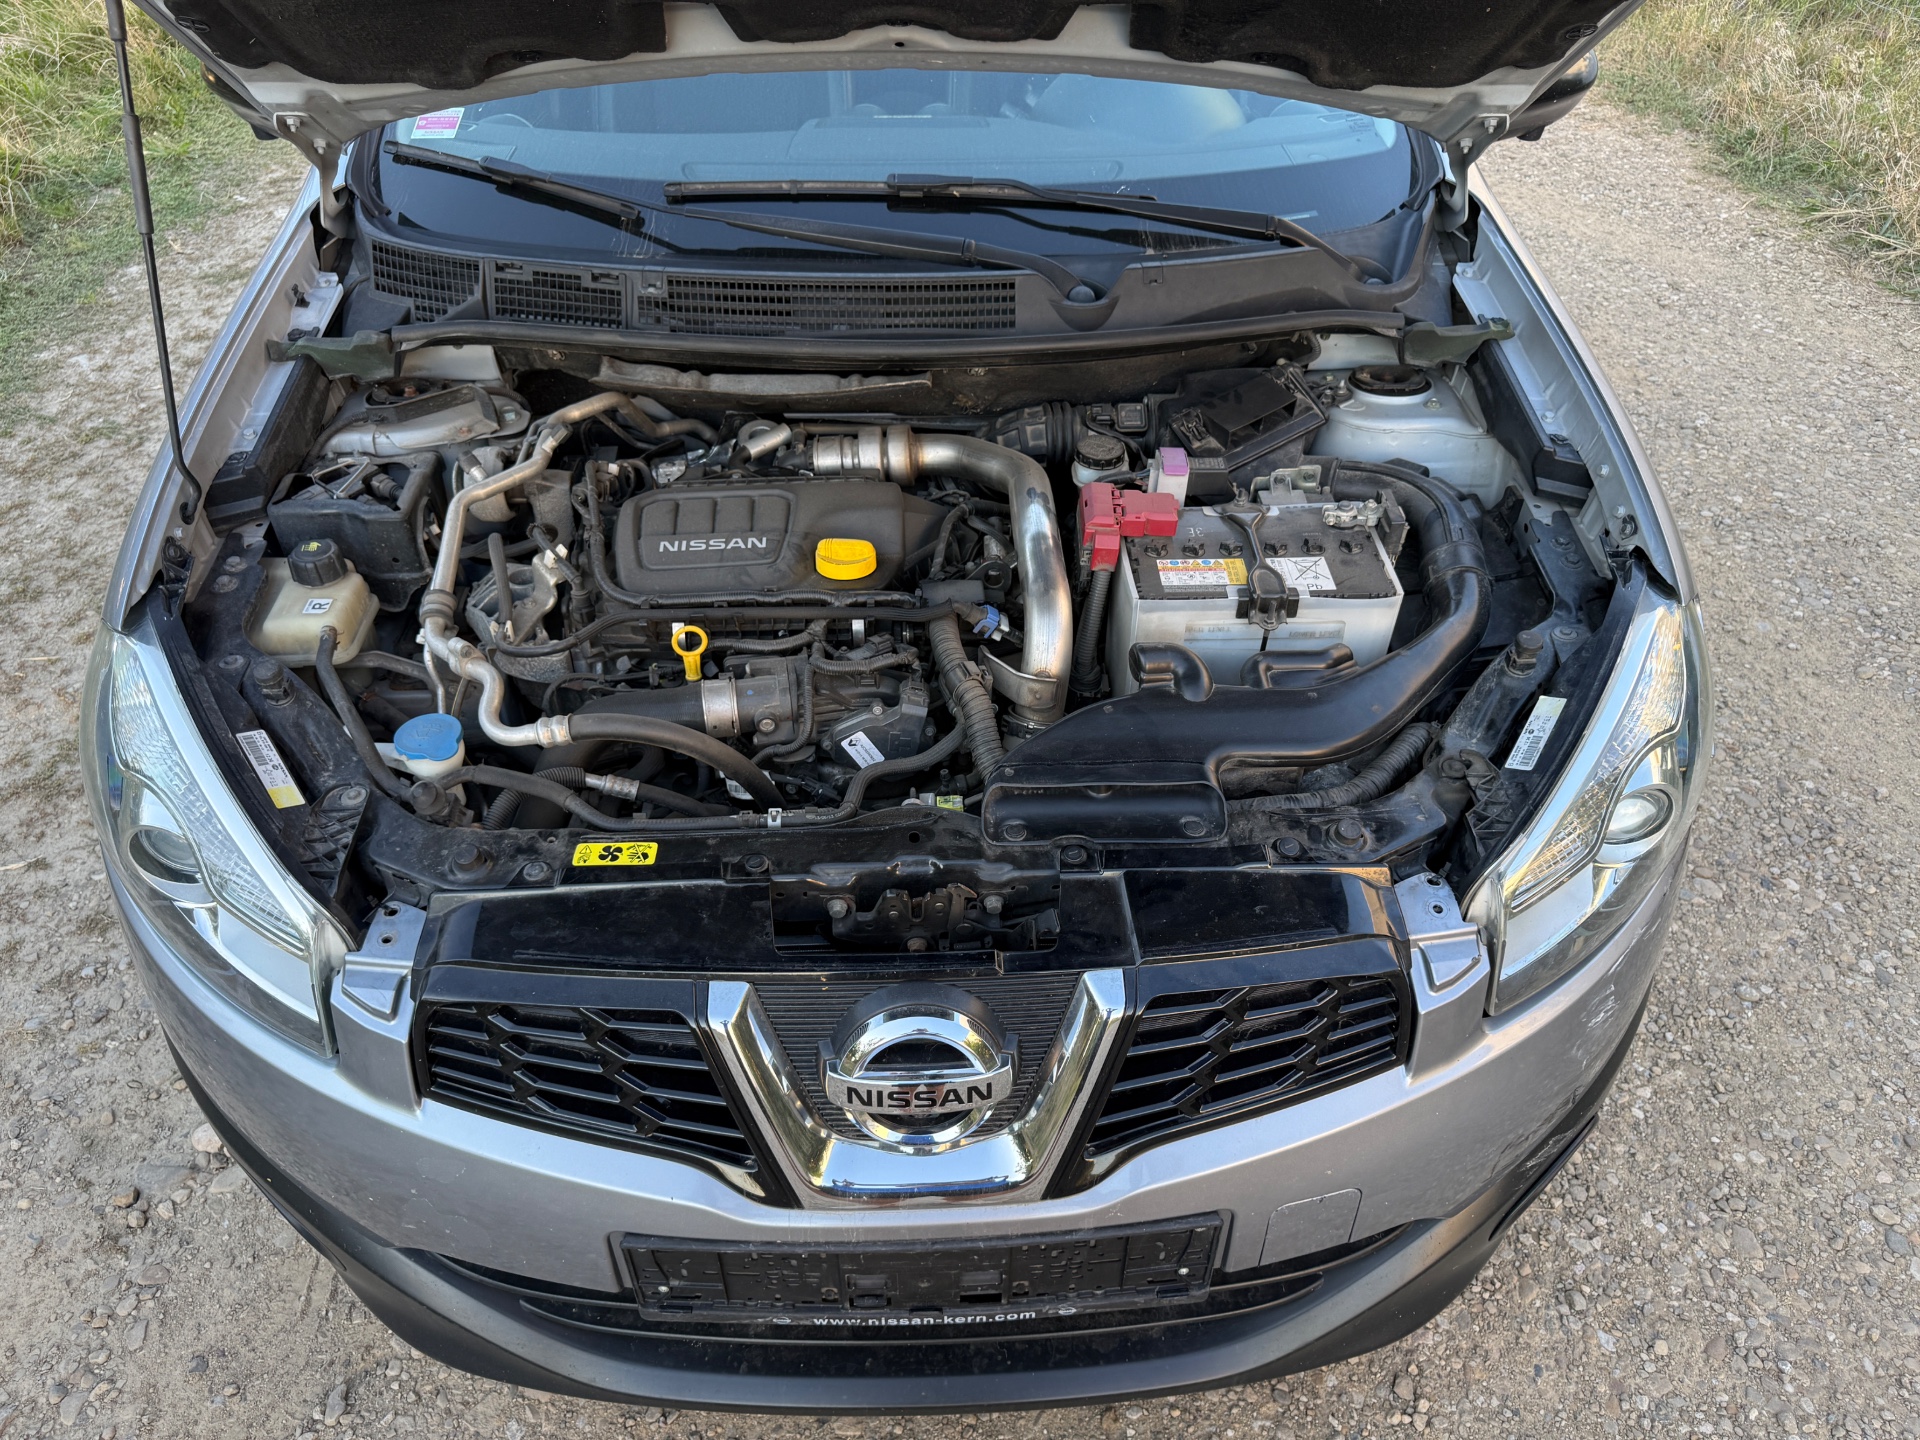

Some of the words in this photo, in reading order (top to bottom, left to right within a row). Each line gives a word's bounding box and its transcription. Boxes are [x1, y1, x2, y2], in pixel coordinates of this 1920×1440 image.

[659, 537, 767, 552] NISSAN
[311, 602, 330, 610] R
[846, 1082, 993, 1108] NISSAN
[813, 1310, 1036, 1326] www.nissan-kern.com
